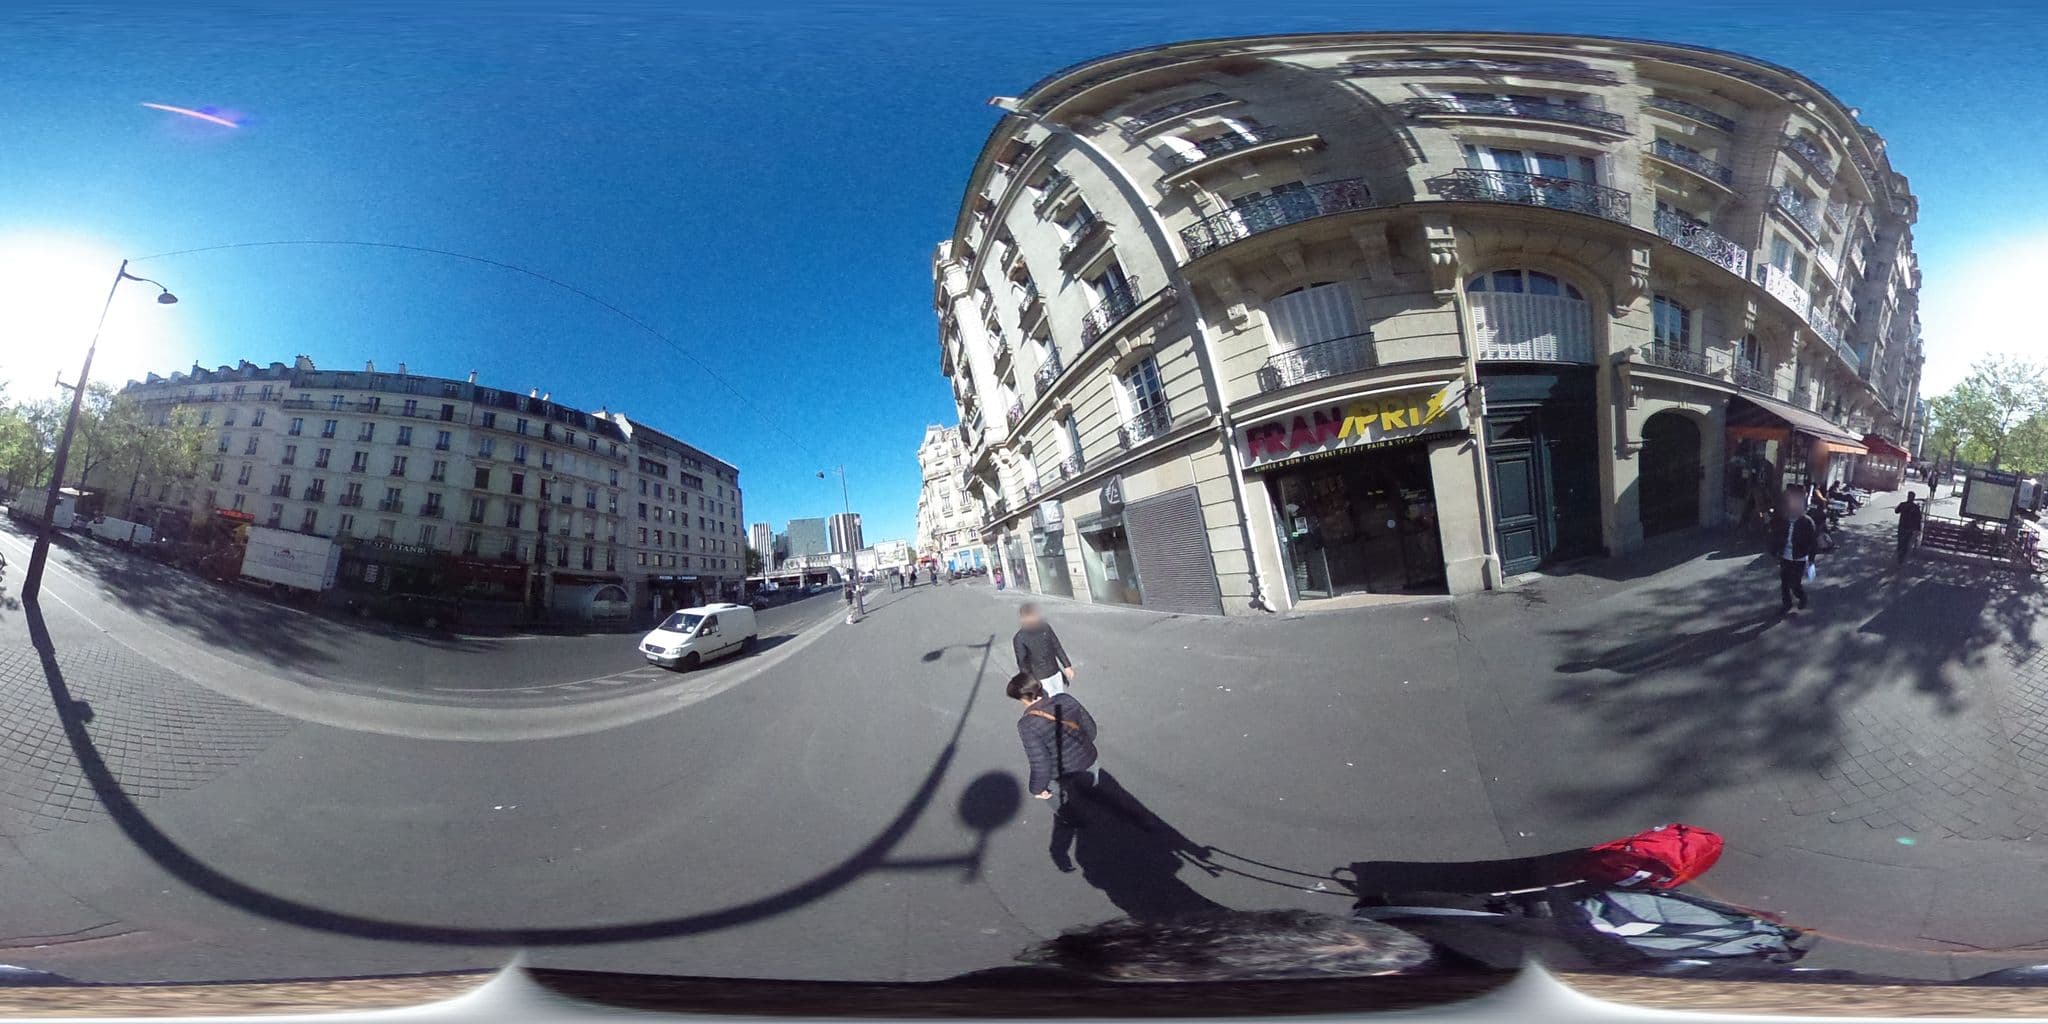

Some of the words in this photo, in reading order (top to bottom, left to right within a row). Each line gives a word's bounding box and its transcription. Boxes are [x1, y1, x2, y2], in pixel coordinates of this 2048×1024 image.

[1286, 458, 1300, 466] BON
[1309, 451, 1336, 461] OUVERT
[1367, 442, 1385, 450] PAIN
